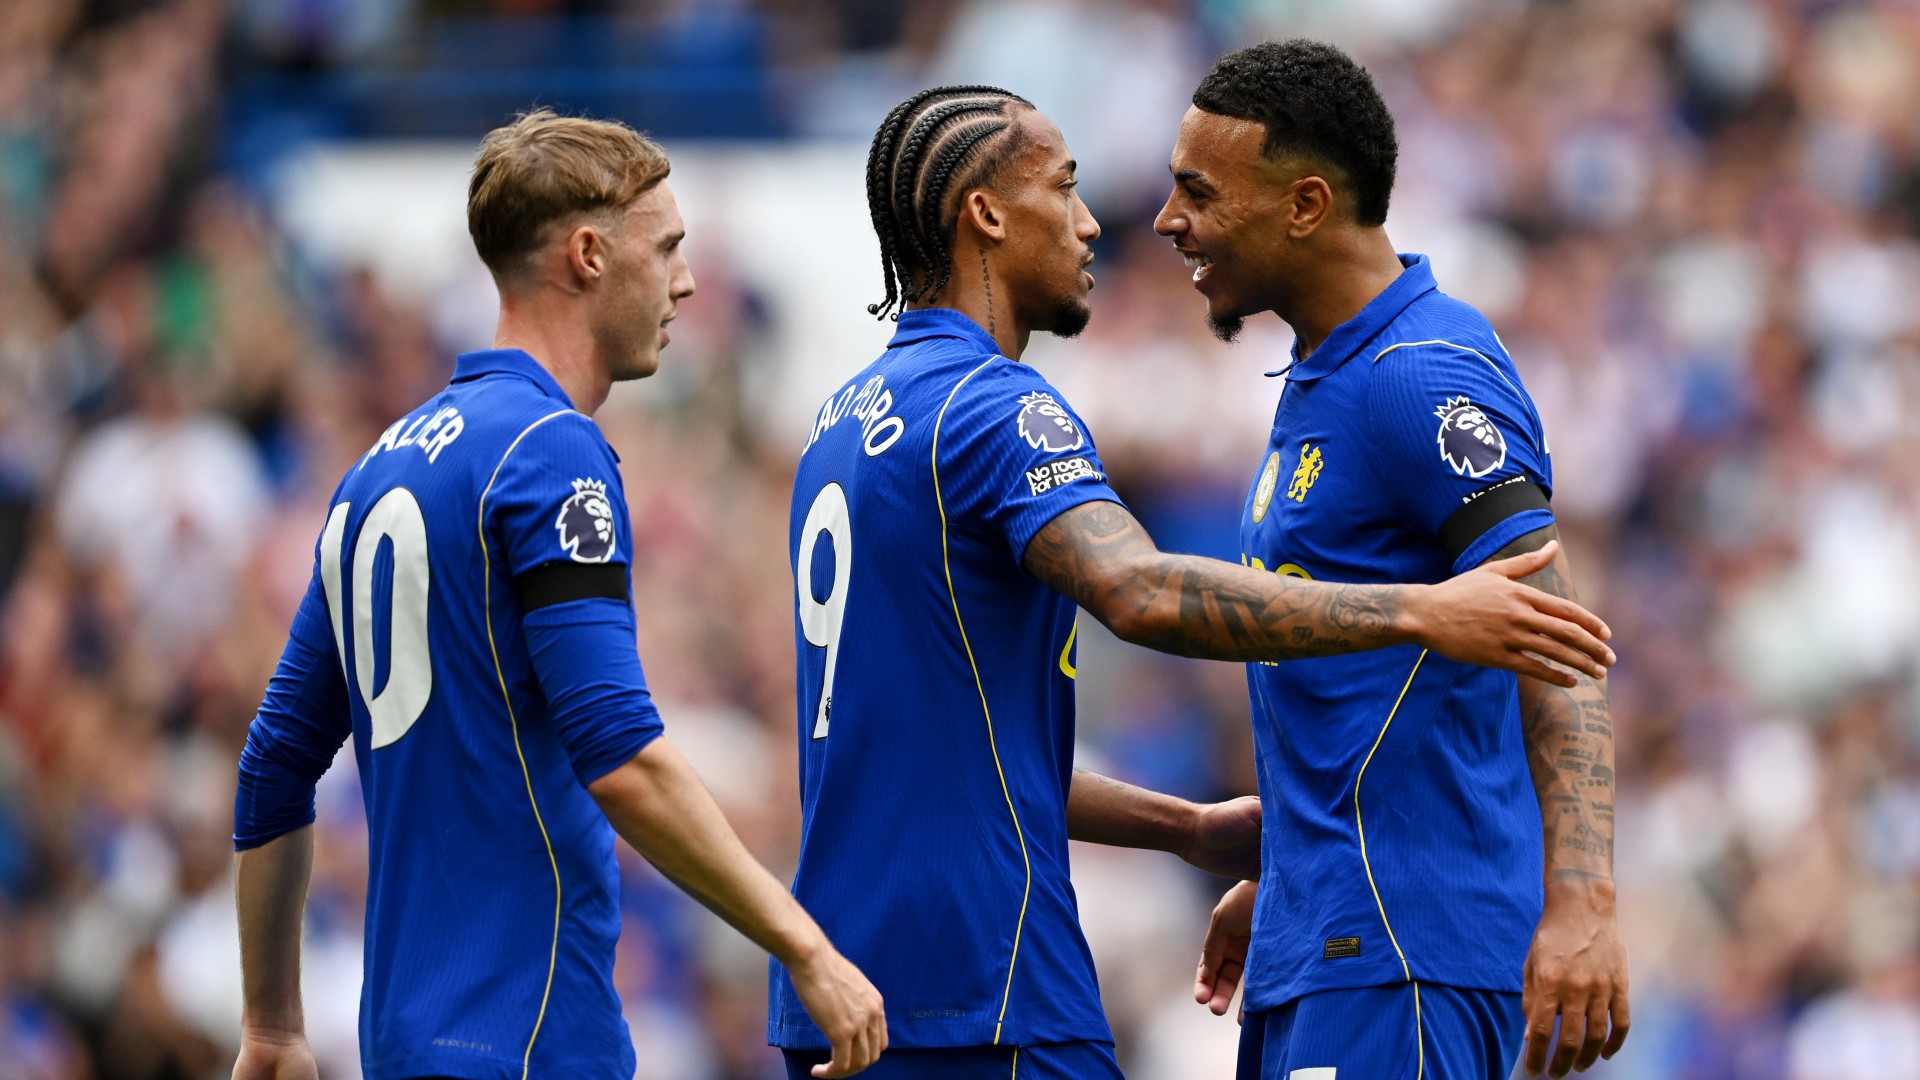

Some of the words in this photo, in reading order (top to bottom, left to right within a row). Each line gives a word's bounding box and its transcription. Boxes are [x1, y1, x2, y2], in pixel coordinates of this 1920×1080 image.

[1025, 466, 1051, 486] No
[320, 486, 433, 750] 10
[797, 481, 852, 740] 9
